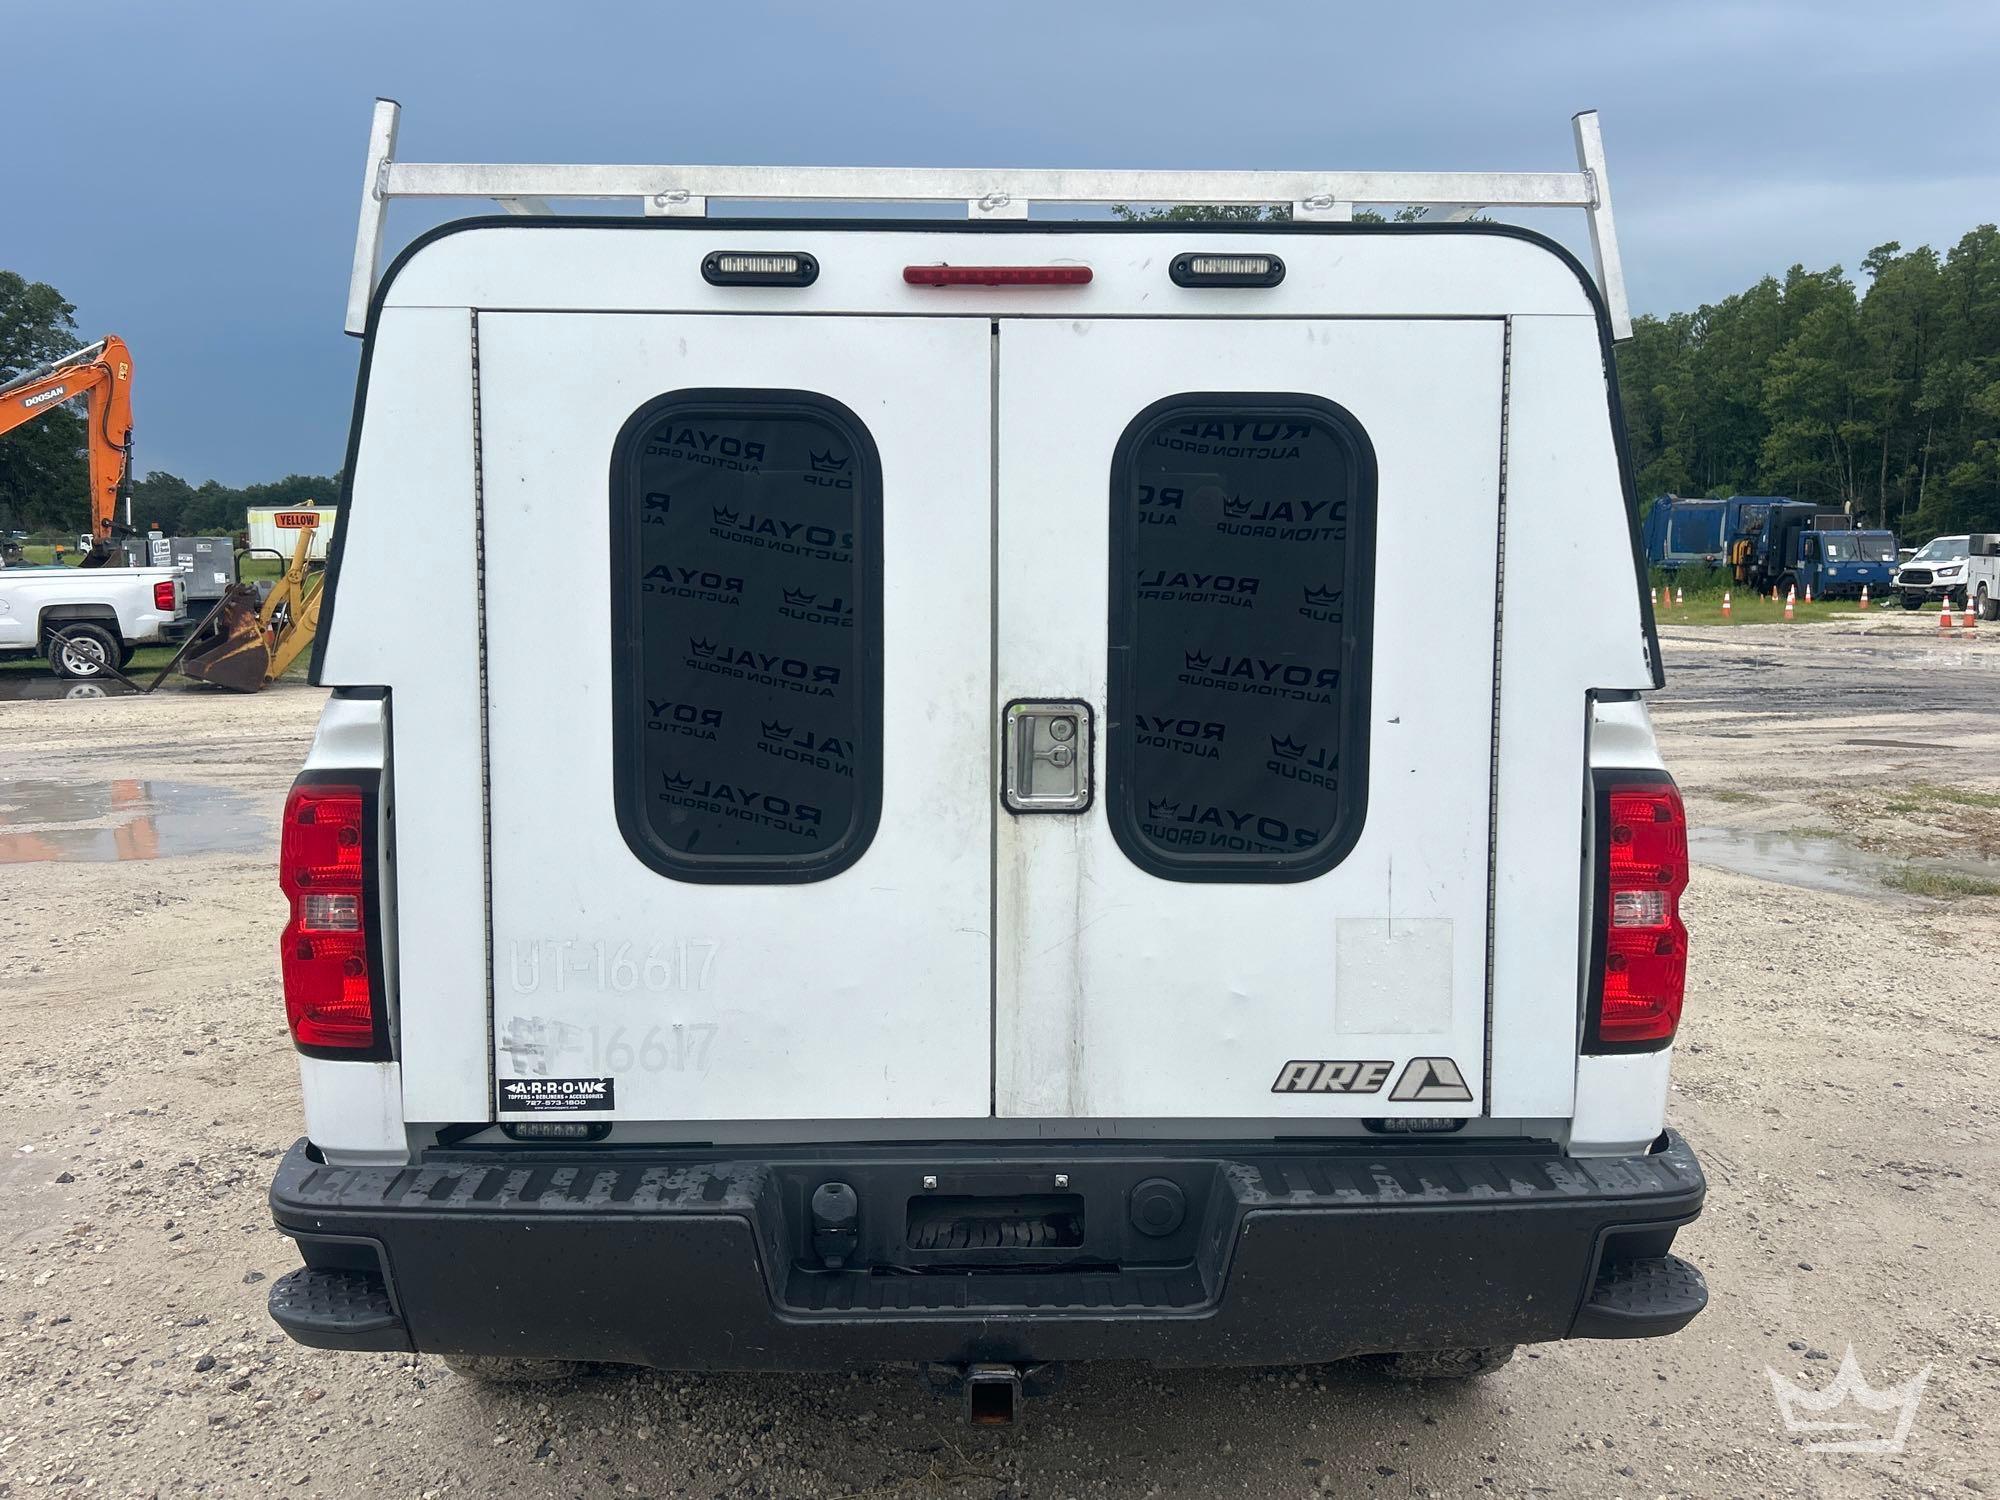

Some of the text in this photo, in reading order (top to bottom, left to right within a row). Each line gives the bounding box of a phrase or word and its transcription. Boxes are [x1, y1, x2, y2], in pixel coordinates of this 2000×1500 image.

[25, 386, 64, 407] DOOSAN
[280, 515, 315, 526] YELLOW
[510, 937, 722, 995] UT-16617
[1271, 1060, 1395, 1093] ARE
